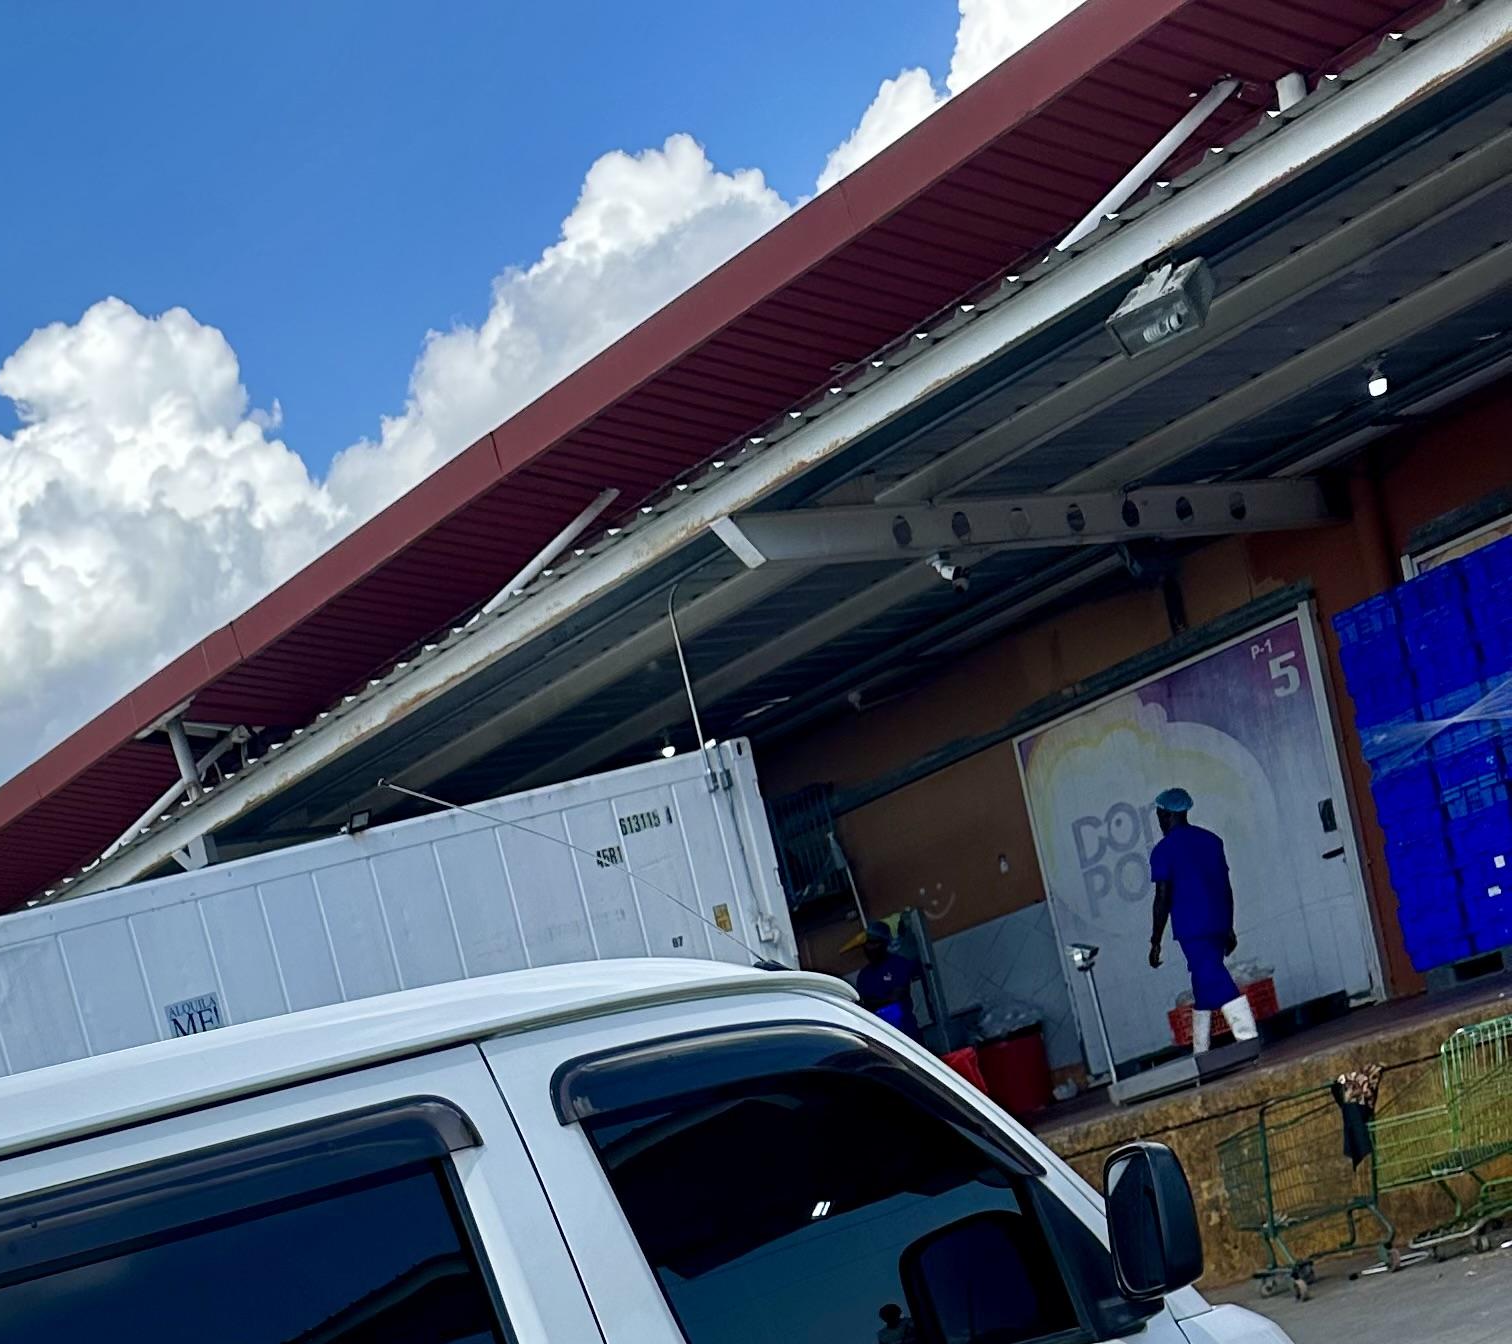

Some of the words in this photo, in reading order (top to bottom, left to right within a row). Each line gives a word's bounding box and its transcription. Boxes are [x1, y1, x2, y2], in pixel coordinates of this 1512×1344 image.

[1250, 638, 1273, 660] P-1
[1268, 650, 1301, 697] 5
[169, 996, 217, 1018] ALQUILA
